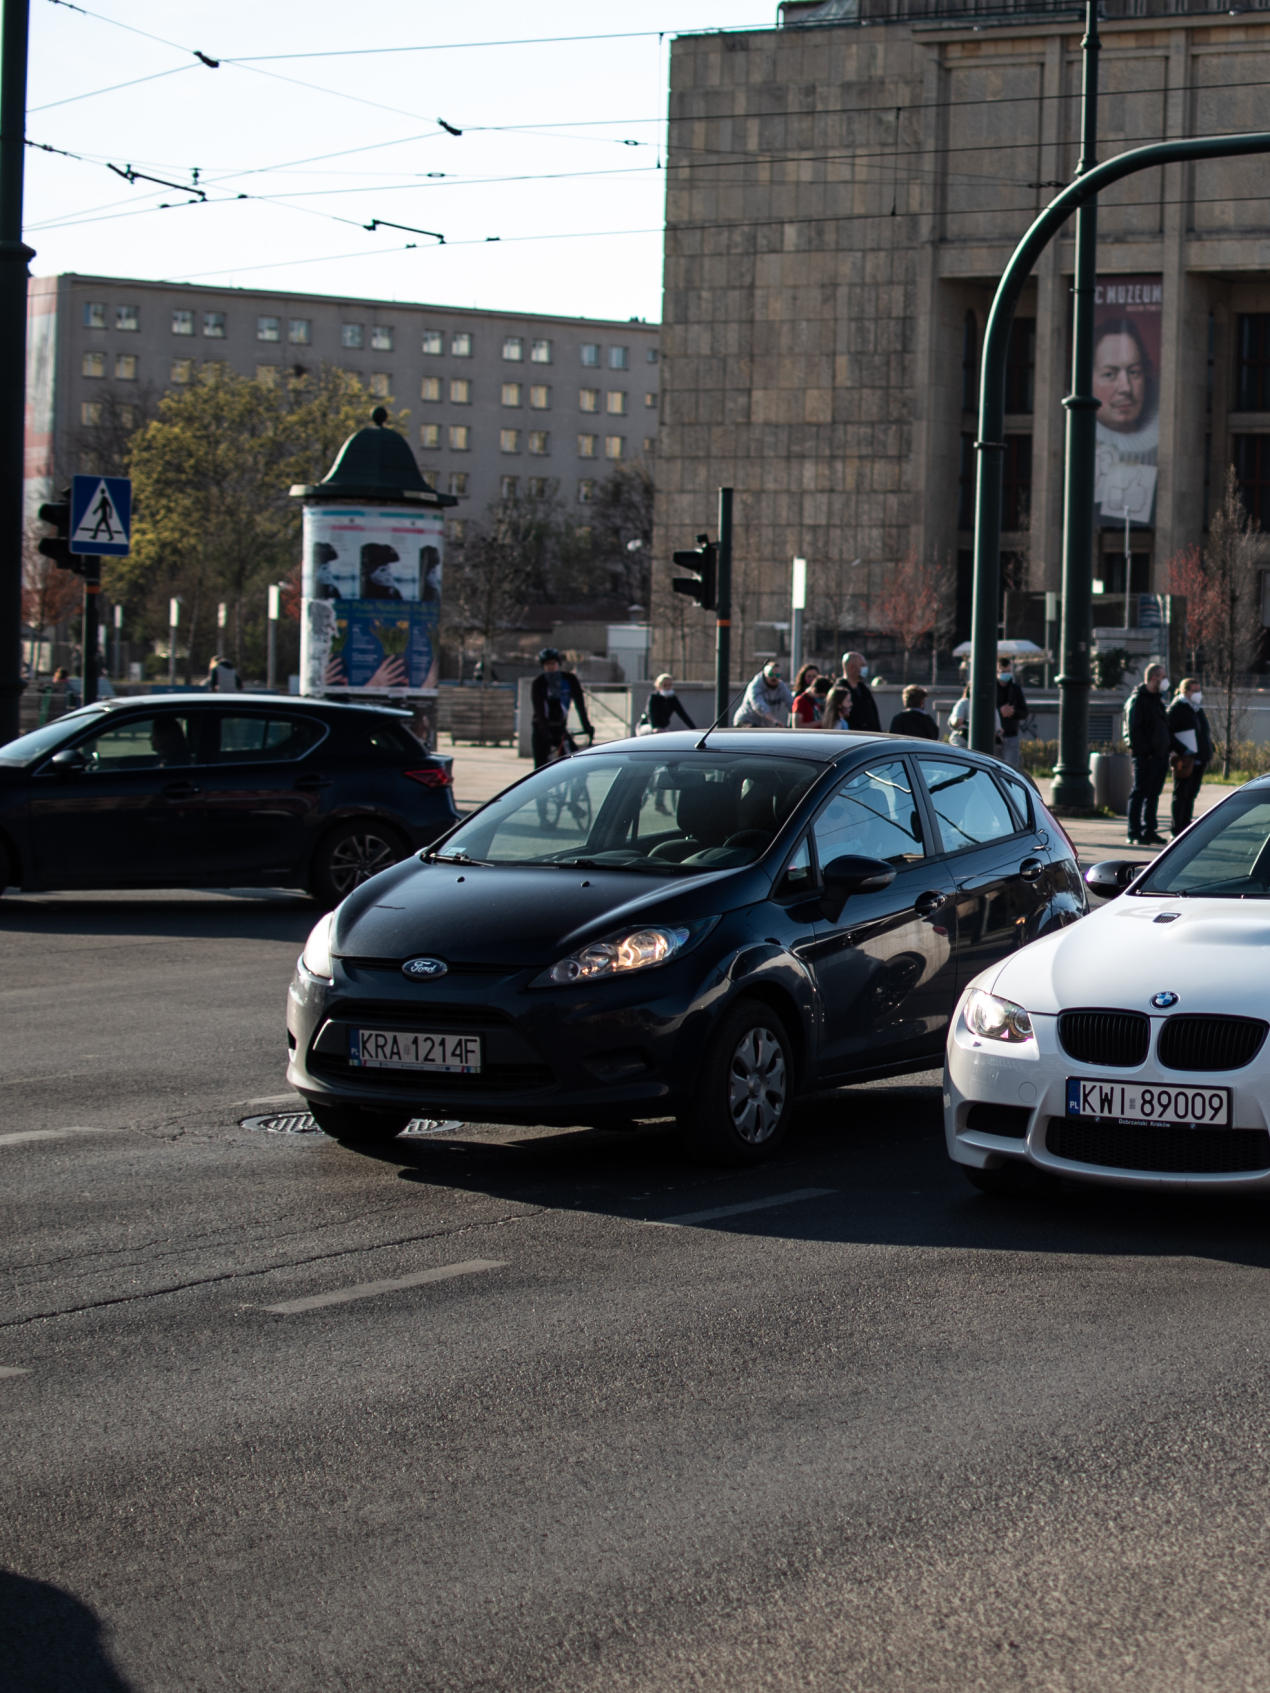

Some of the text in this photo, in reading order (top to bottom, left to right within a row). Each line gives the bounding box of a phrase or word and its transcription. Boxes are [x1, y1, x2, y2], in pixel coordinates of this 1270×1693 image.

[1106, 285, 1161, 304] MUZEUM
[410, 960, 437, 973] Ford
[361, 1032, 478, 1064] KRA 1214F
[1069, 1101, 1079, 1109] PL
[1082, 1084, 1224, 1121] KWI 89009
